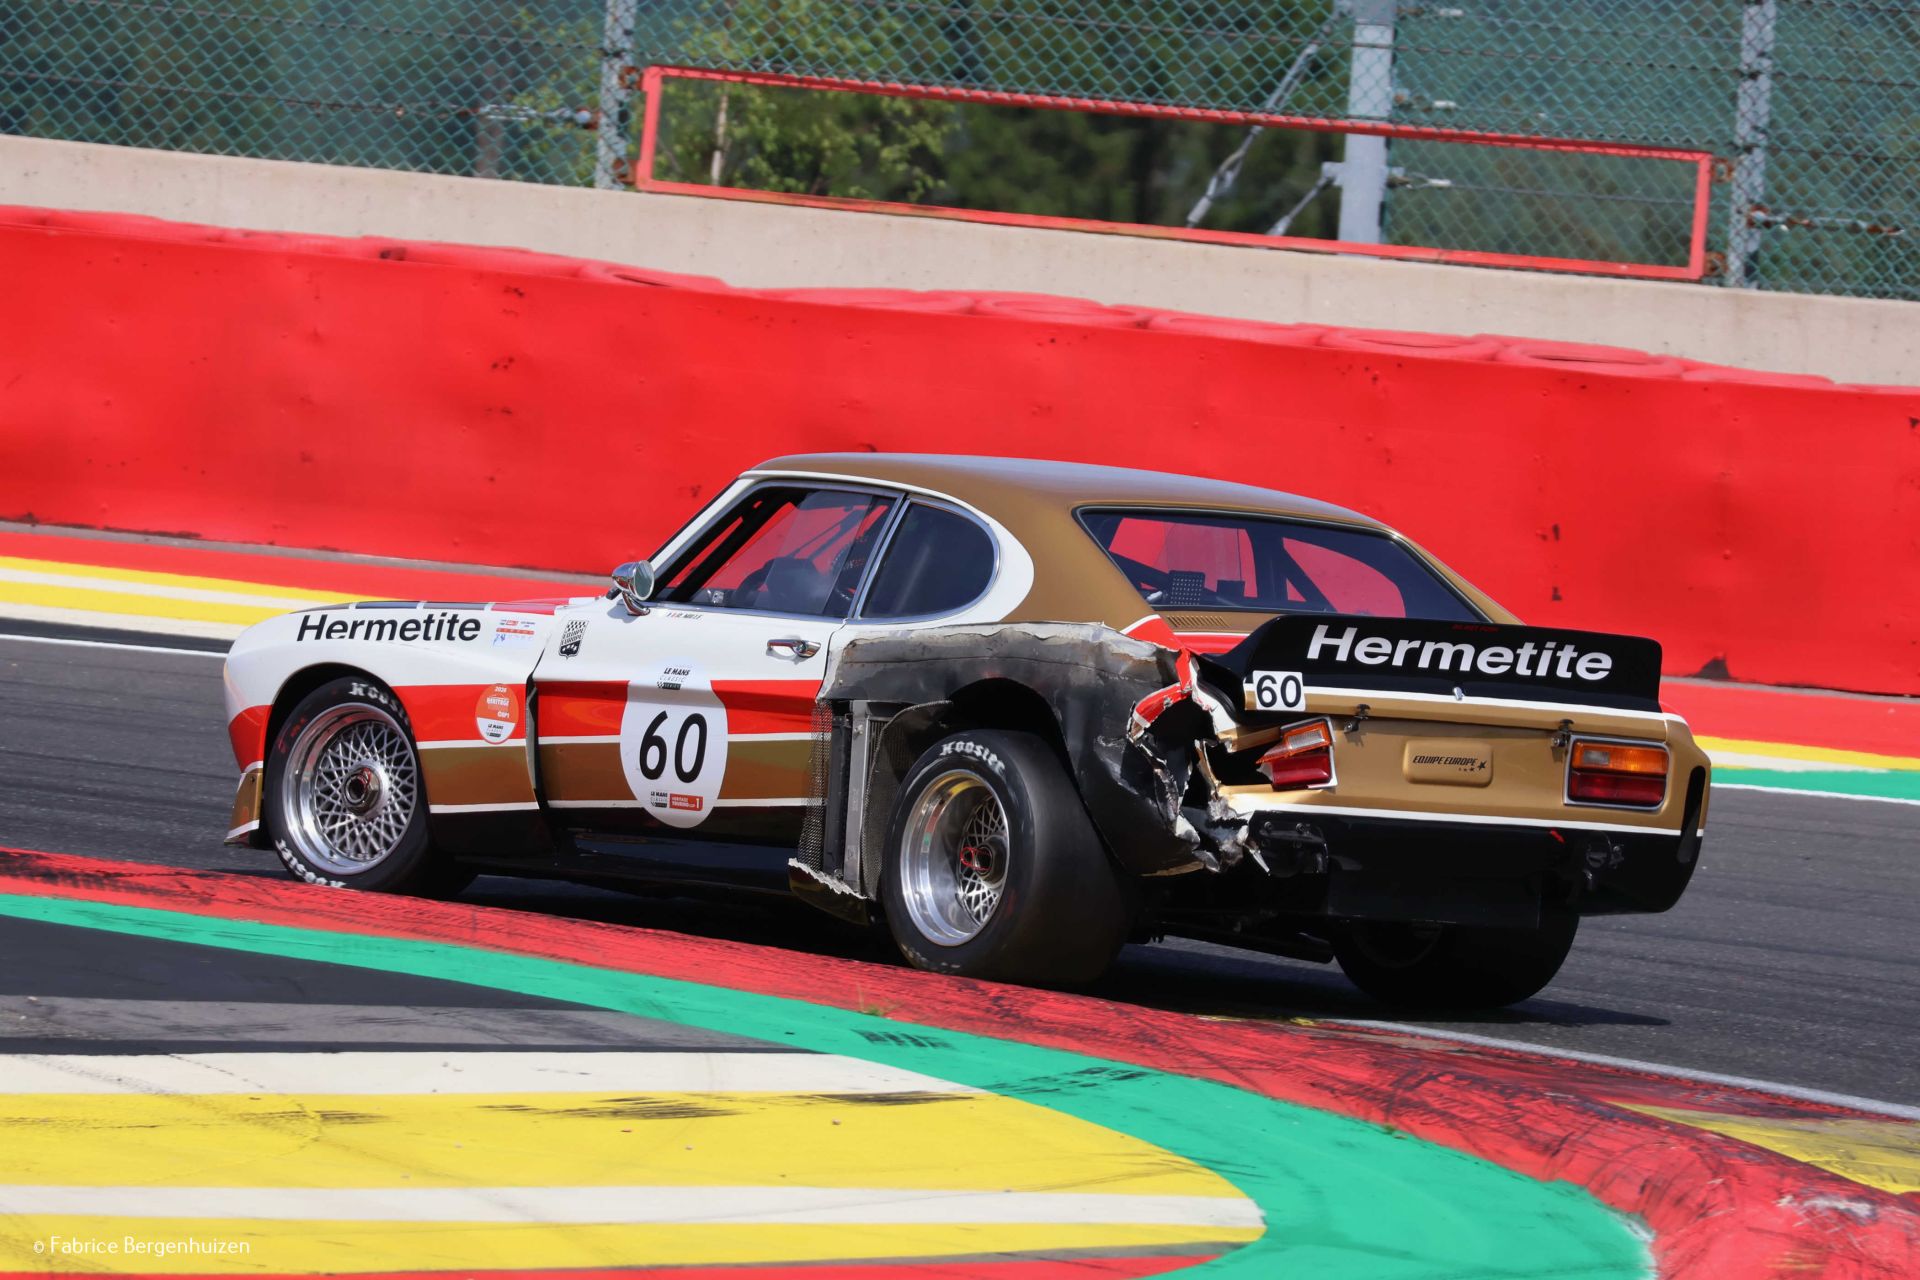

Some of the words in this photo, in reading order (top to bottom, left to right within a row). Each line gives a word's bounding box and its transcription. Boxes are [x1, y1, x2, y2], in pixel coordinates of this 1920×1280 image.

[297, 612, 481, 641] Hermetite
[1306, 624, 1613, 680] Hermetite
[660, 675, 687, 683] CLASSIC
[664, 667, 671, 675] LE
[671, 668, 691, 676] MANS
[1256, 674, 1302, 708] 60
[639, 711, 707, 783] 60
[1413, 755, 1445, 764] EQUIPE
[1443, 756, 1478, 766] EUROPE
